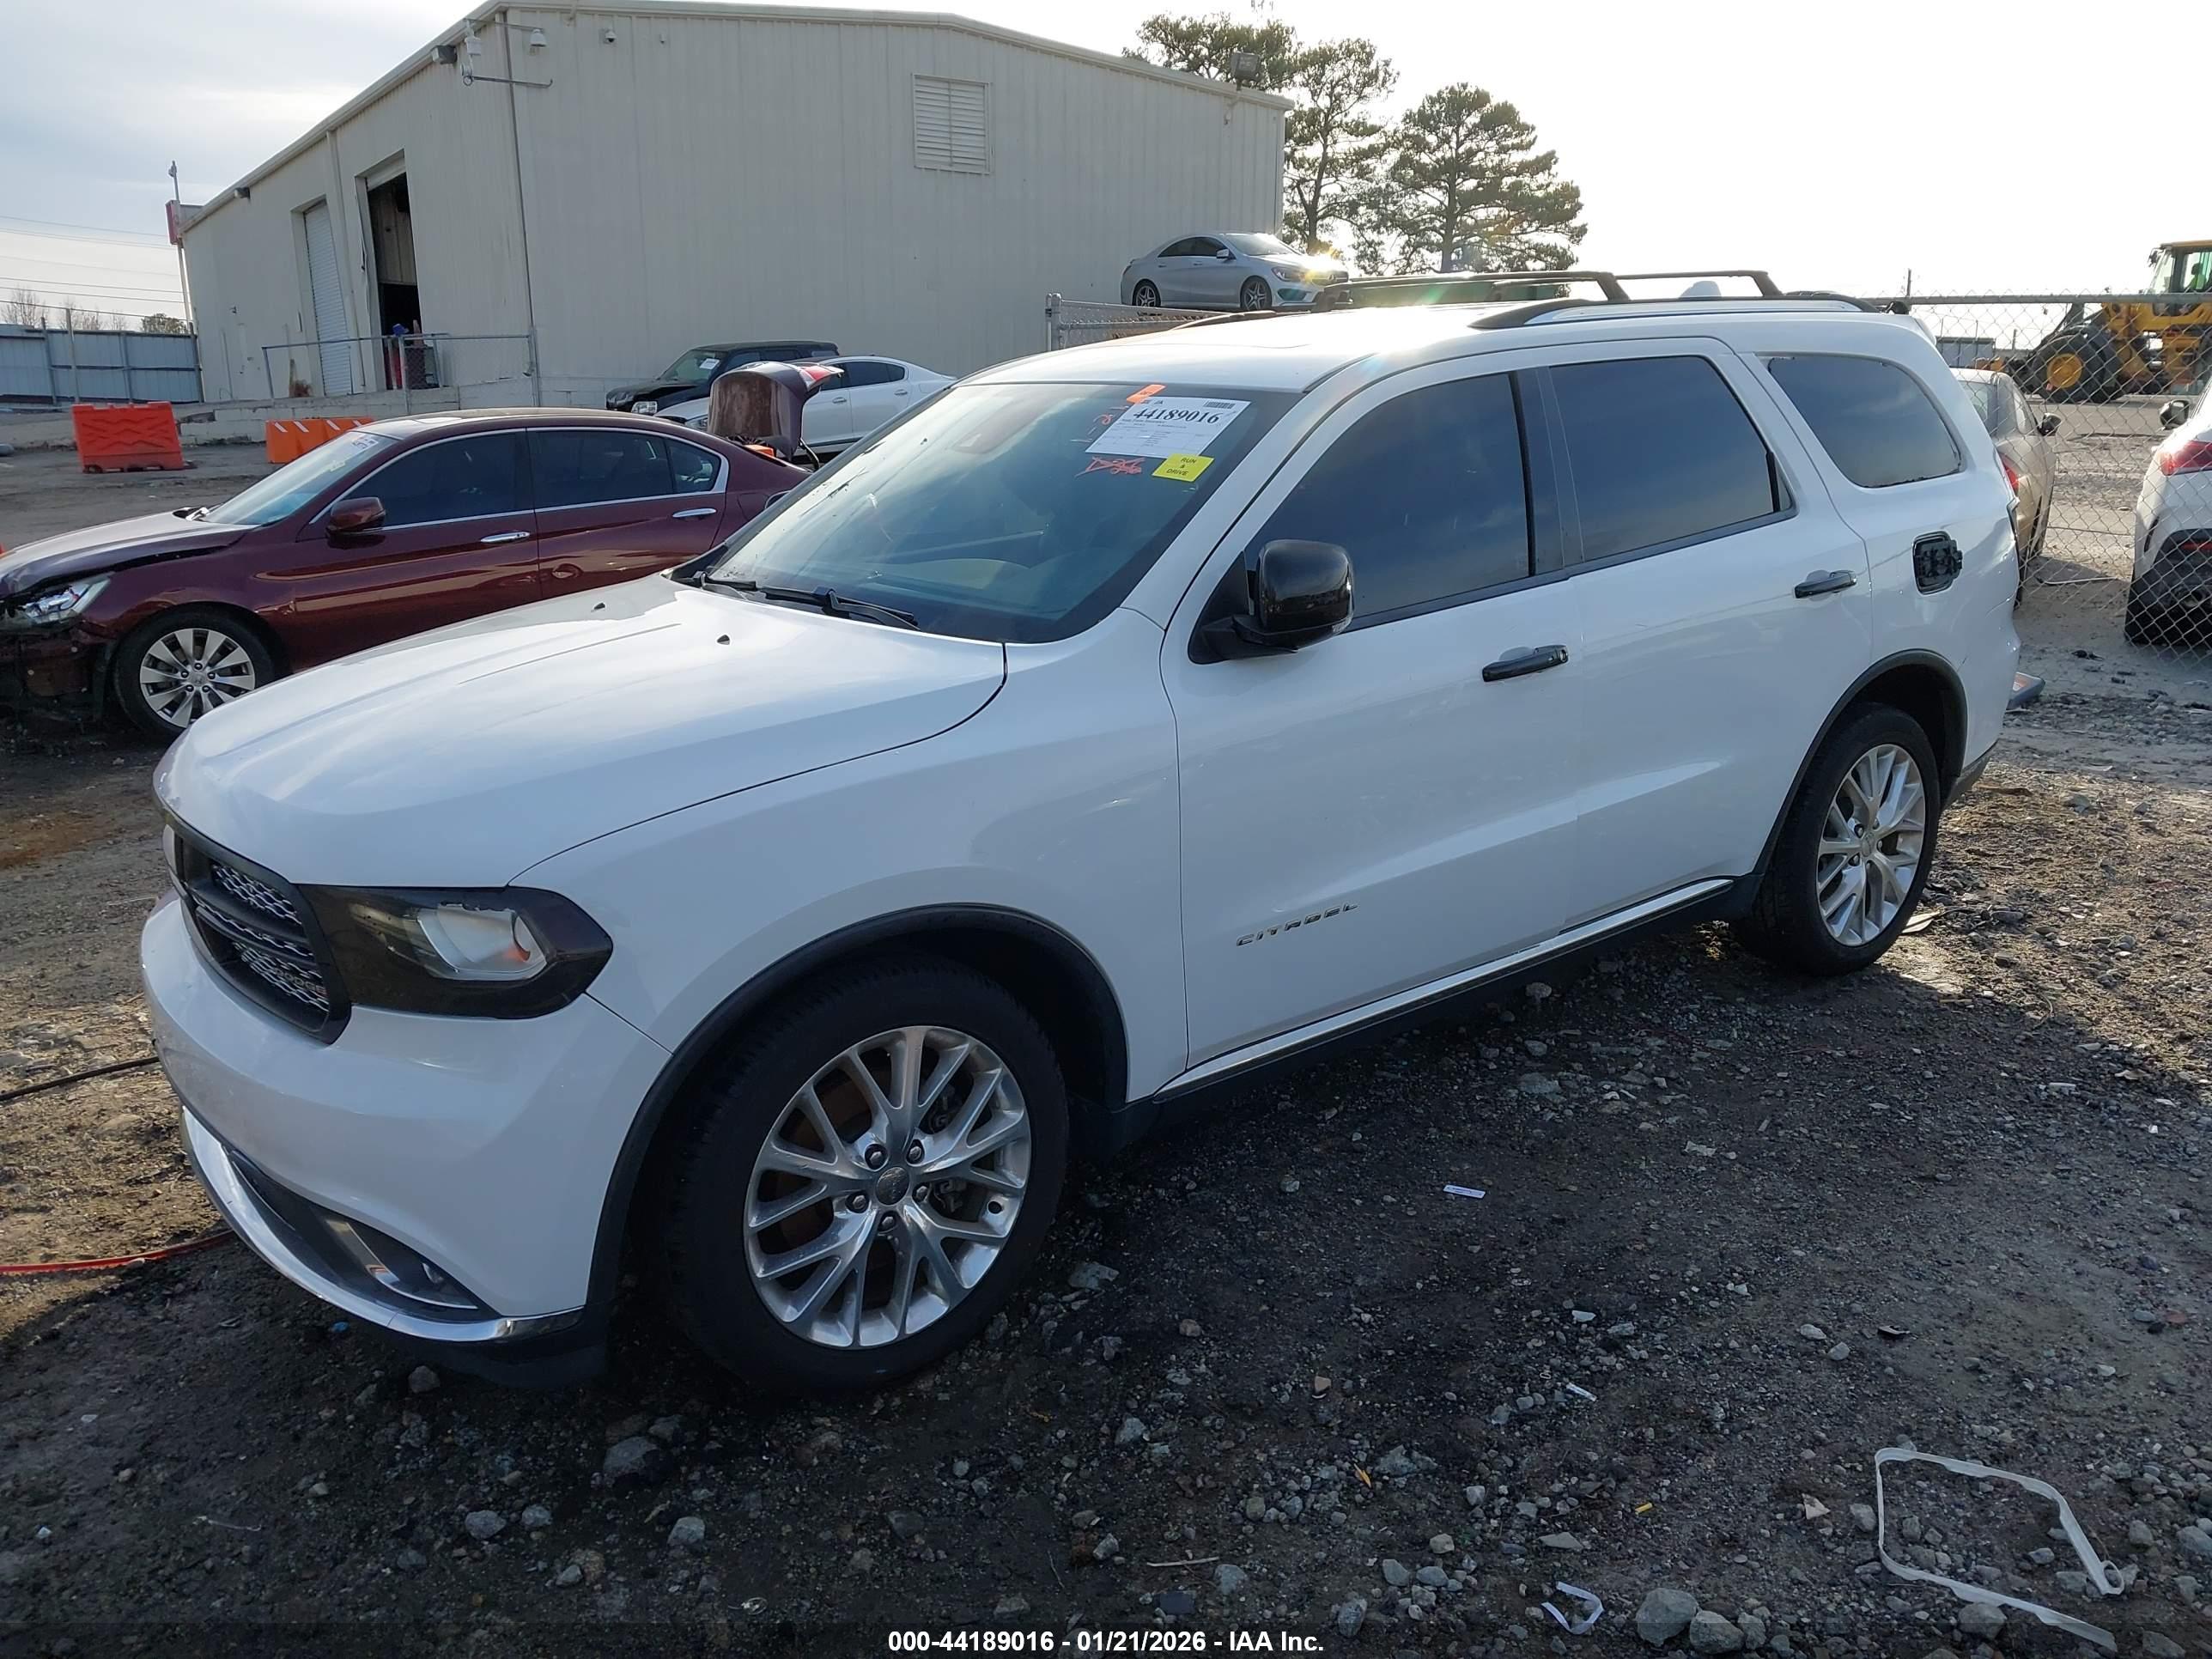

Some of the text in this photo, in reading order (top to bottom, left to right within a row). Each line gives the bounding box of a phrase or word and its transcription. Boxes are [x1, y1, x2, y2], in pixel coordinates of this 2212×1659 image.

[1133, 409, 1224, 424] 44189016
[1166, 468, 1189, 477] DRIVE
[1237, 902, 1358, 946] CITADEL
[275, 968, 327, 995] DODGE
